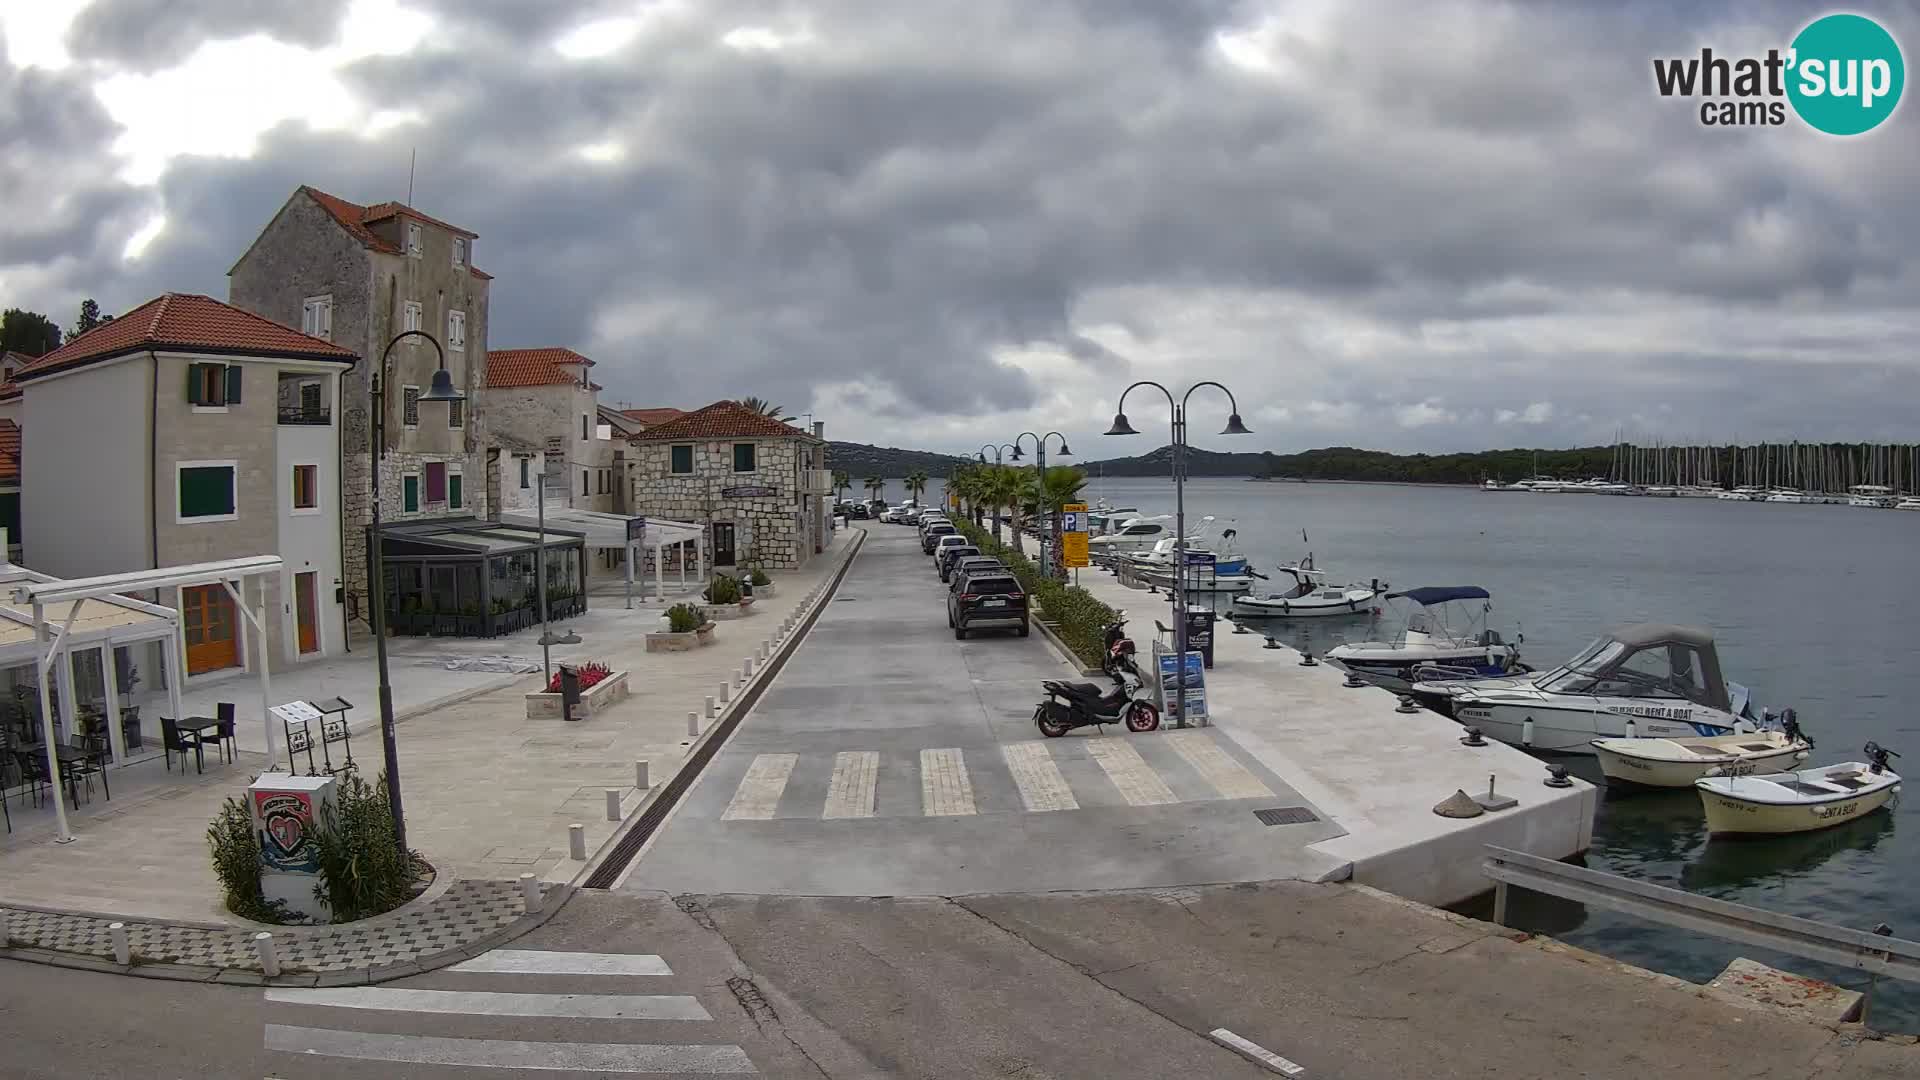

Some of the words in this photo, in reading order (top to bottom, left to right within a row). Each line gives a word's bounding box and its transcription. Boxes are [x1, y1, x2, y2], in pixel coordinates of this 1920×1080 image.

[1065, 515, 1075, 530] P
[1645, 707, 1666, 717] RENT
[1666, 708, 1672, 718] A
[1673, 708, 1692, 720] BOAT
[1739, 765, 1757, 775] BOAT
[1842, 802, 1858, 814] BOAT
